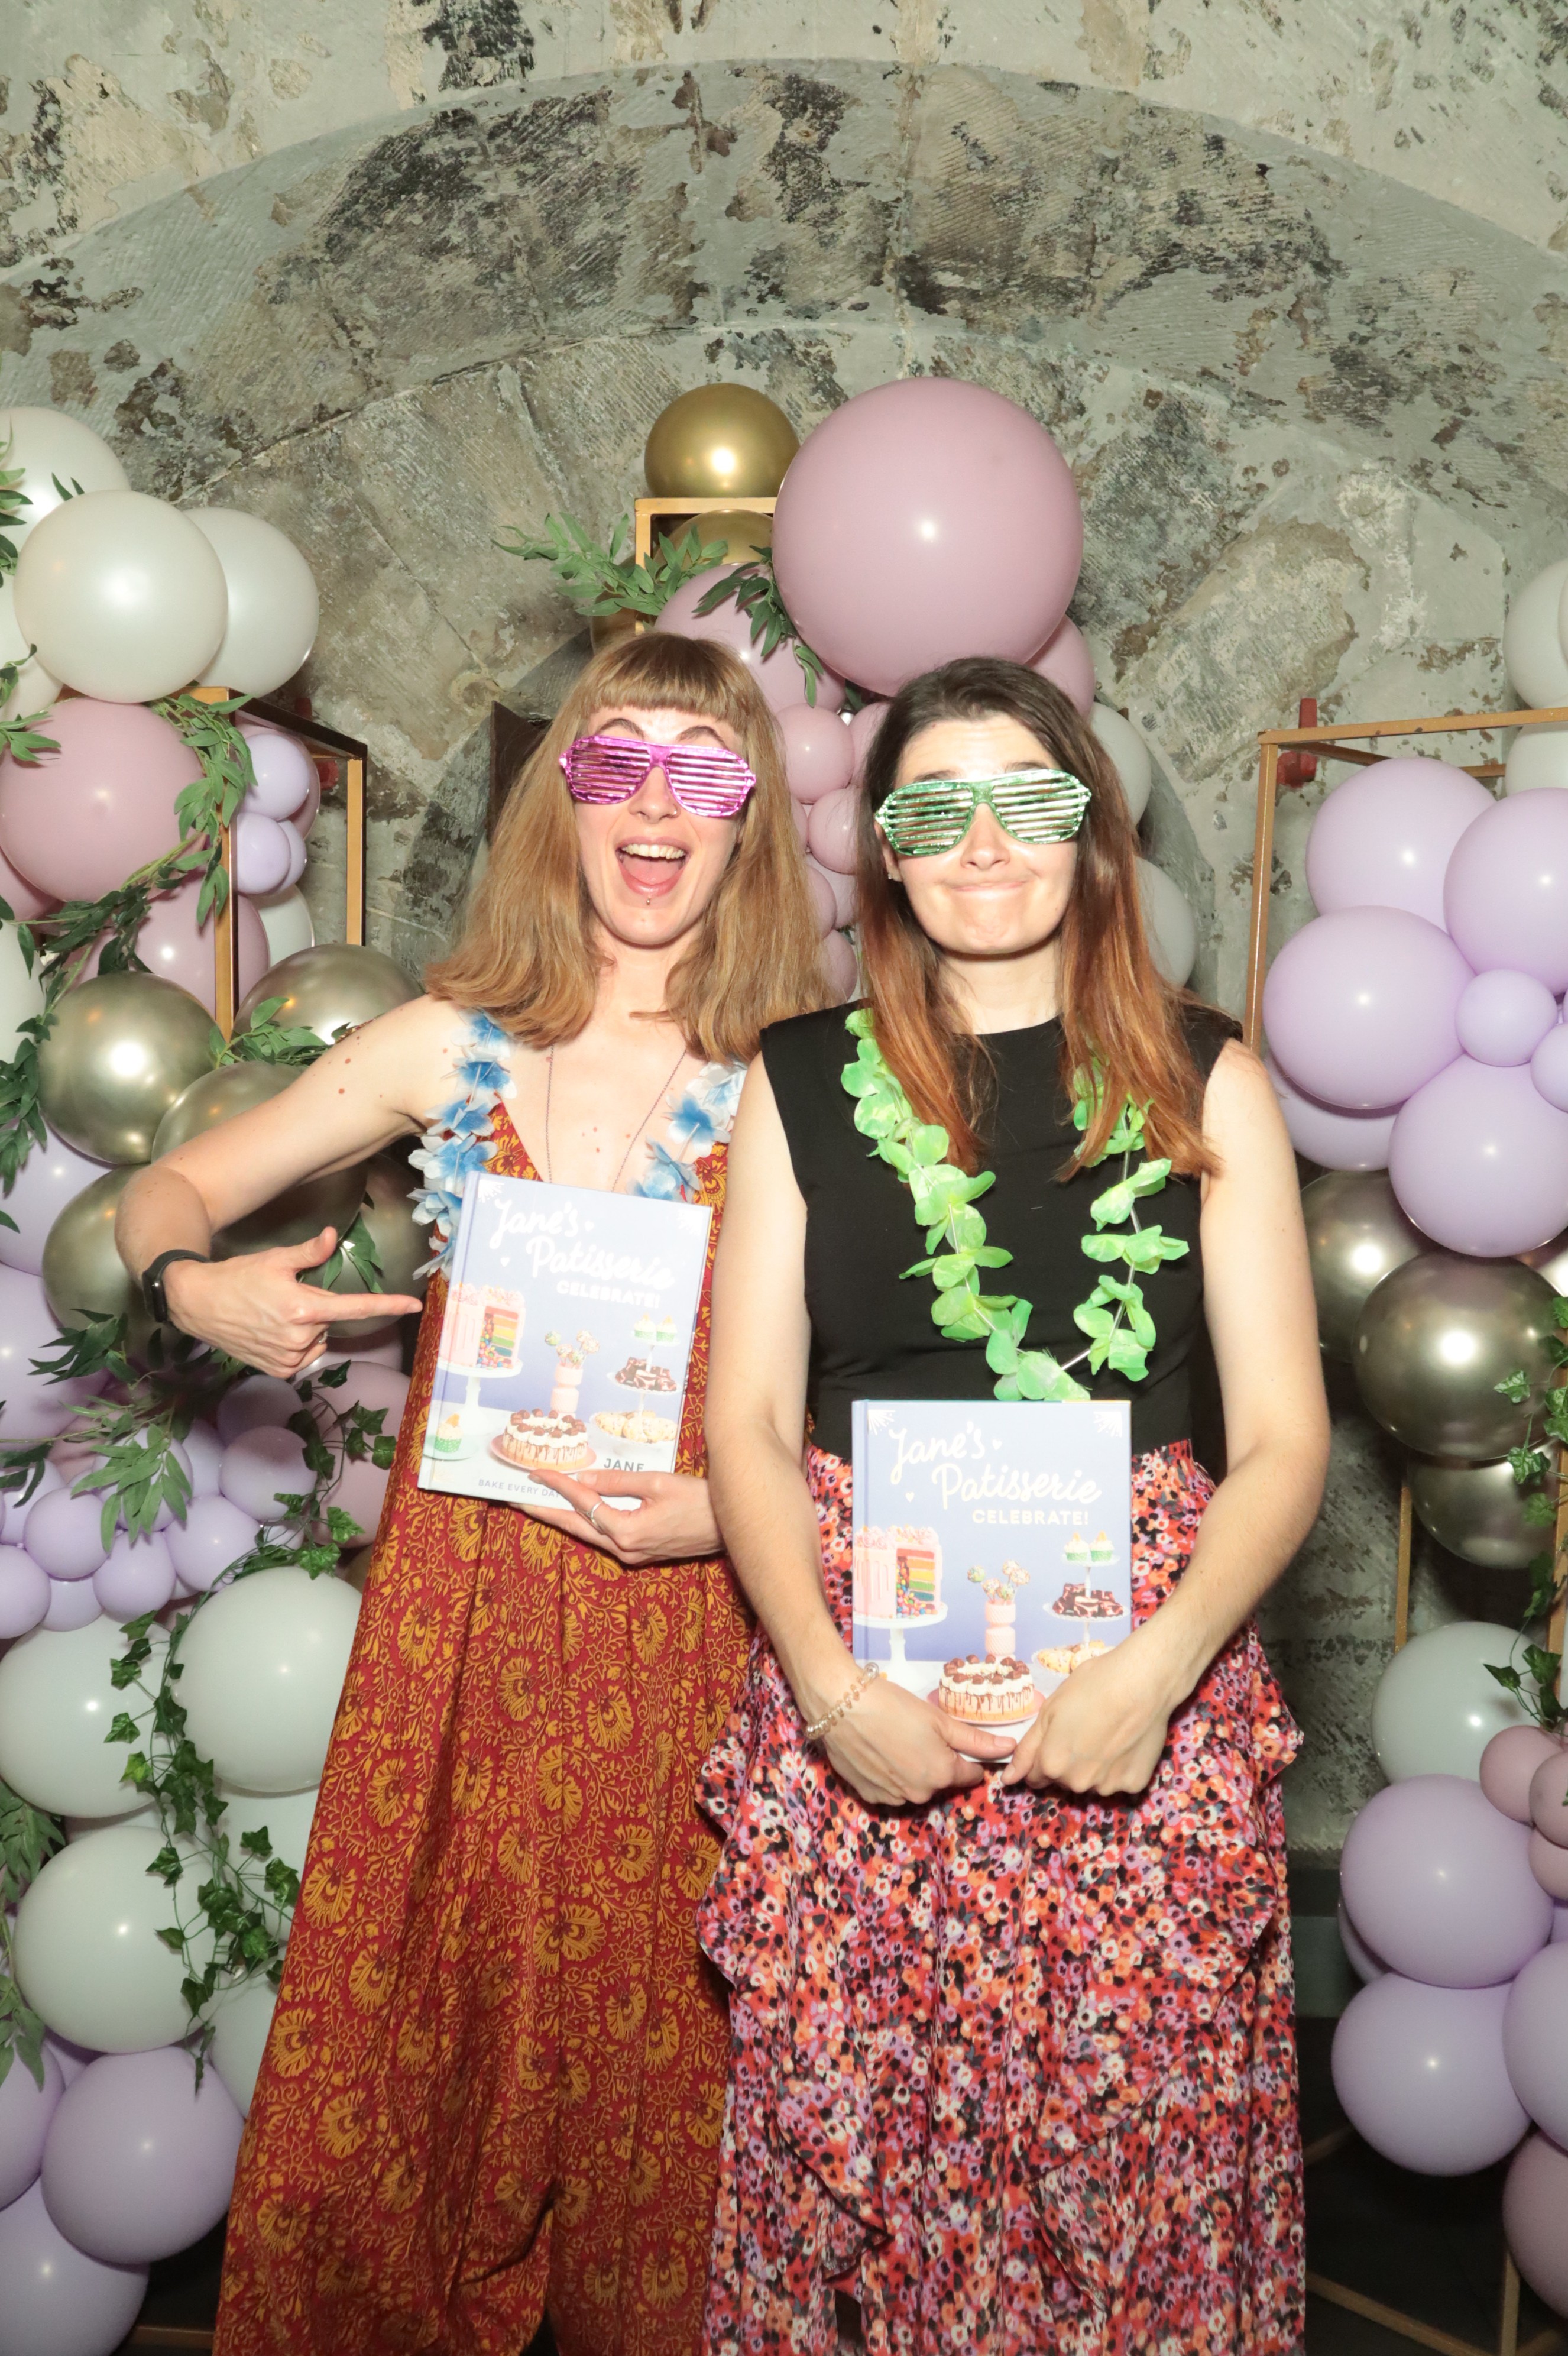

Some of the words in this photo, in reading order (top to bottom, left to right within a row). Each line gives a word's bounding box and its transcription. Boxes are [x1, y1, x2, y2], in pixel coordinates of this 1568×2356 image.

[489, 1198, 579, 1250] Jane's
[526, 1235, 675, 1290] Patisserie
[556, 1280, 660, 1309] CELEBRATE!
[889, 1420, 986, 1485] Jane's
[478, 1478, 504, 1490] BAKE
[507, 1483, 538, 1496] EVERY
[931, 1462, 1103, 1510] Patisserie
[972, 1509, 1089, 1525] CELEBRATE!
